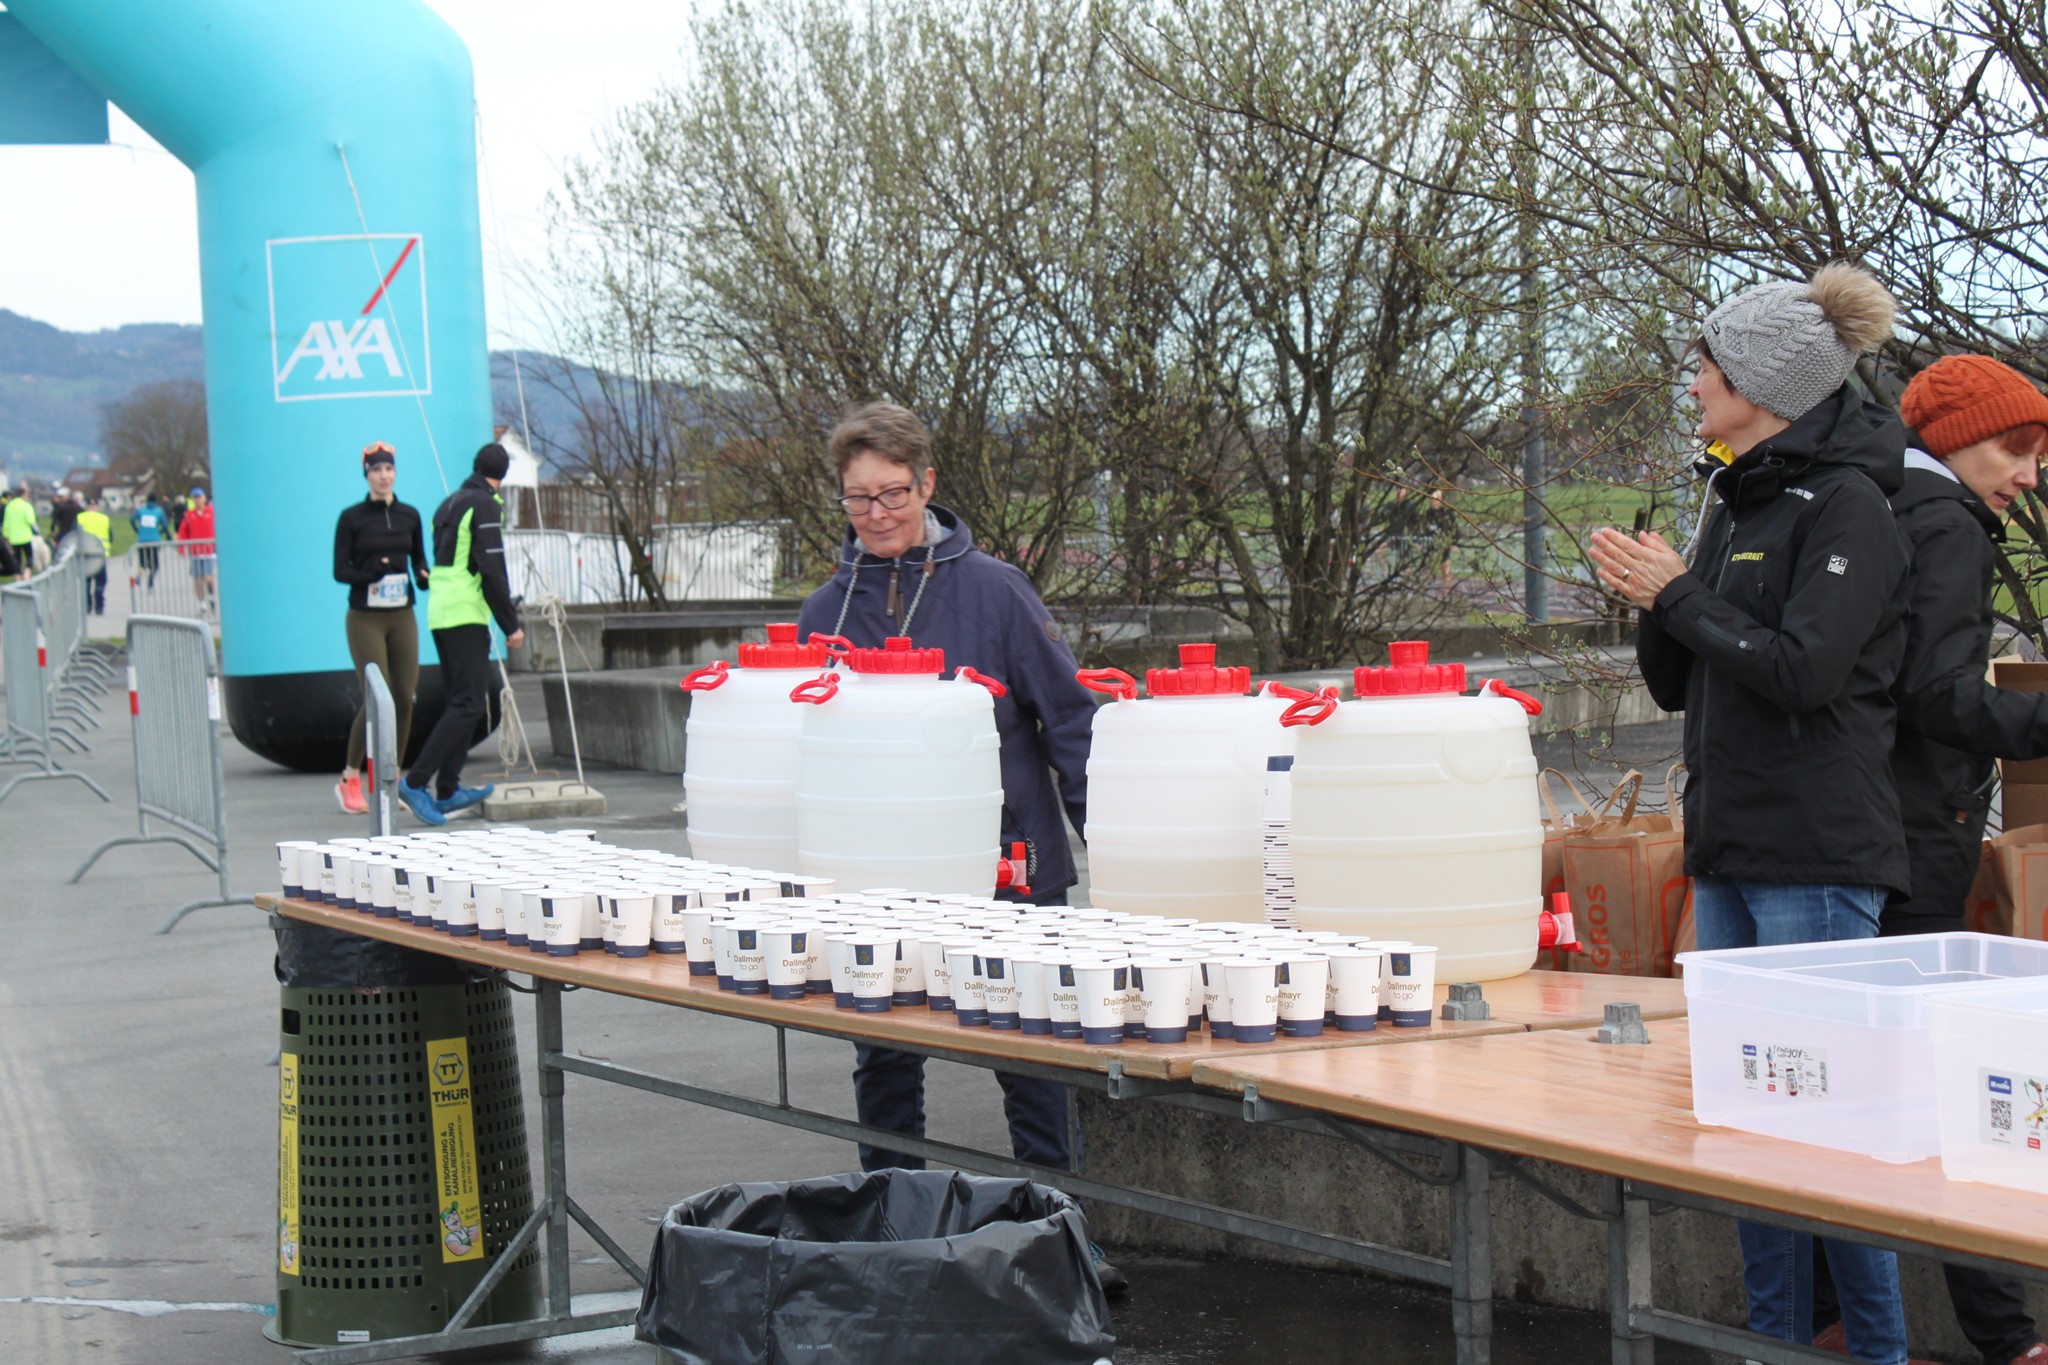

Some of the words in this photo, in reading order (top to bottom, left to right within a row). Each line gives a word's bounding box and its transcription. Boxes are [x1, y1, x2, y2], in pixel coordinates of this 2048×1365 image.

[275, 319, 404, 383] AXA
[1586, 883, 1612, 975] IGROS
[733, 955, 765, 964] Dallmayr
[748, 964, 759, 972] go
[852, 970, 884, 980] Dallmayr
[866, 980, 877, 989] go
[1387, 981, 1422, 992] Dallmayr
[996, 995, 1009, 1004] go
[1053, 992, 1079, 1002] Dallm
[1393, 991, 1402, 1000] to
[1401, 992, 1414, 1002] go
[1788, 1047, 1803, 1059] JOY
[440, 1063, 458, 1076] TT
[432, 1087, 470, 1103] THÜR
[447, 1121, 460, 1196] KANALREINIGUNG
[441, 1138, 452, 1197] ENTSORGUNG
